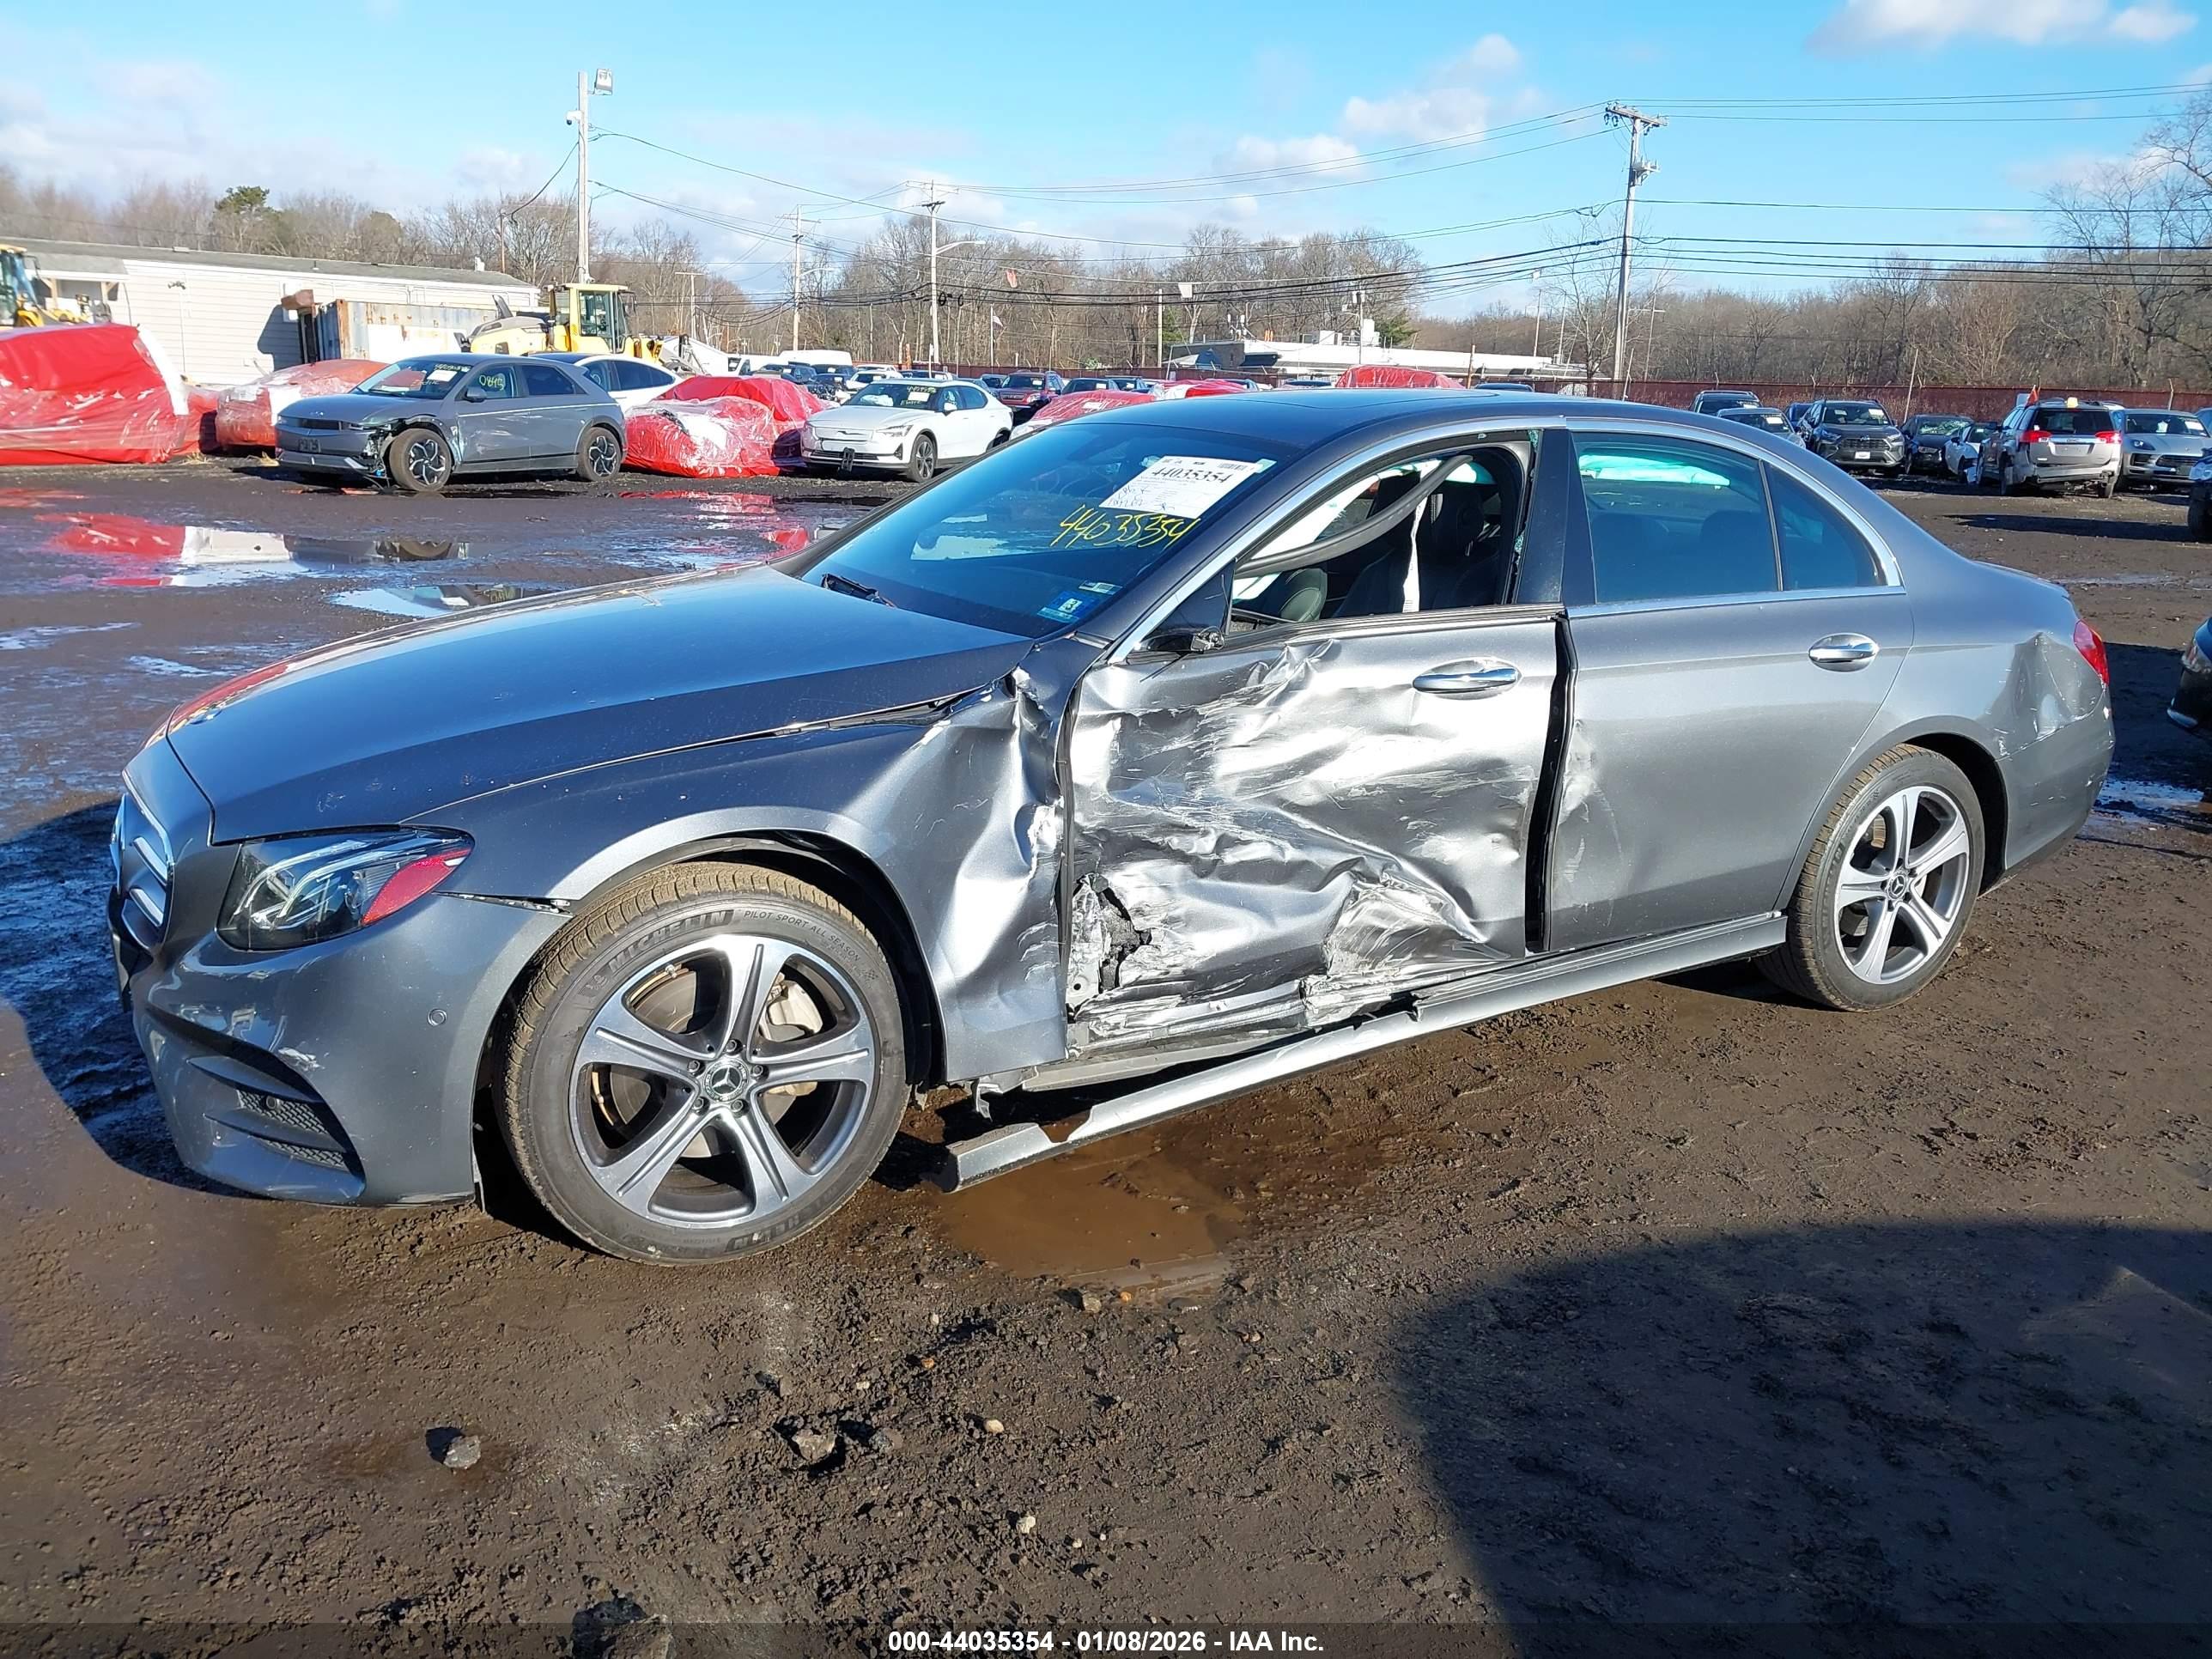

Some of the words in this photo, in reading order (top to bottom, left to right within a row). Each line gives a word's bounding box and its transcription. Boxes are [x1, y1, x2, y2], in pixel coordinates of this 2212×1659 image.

[1152, 466, 1234, 483] 44035354
[1049, 504, 1201, 552] 44035354
[608, 909, 726, 973] MICHELIN
[744, 909, 774, 920] PILOT
[776, 914, 810, 928] SPORT
[811, 925, 827, 938] ALL
[828, 934, 861, 962] SEASON
